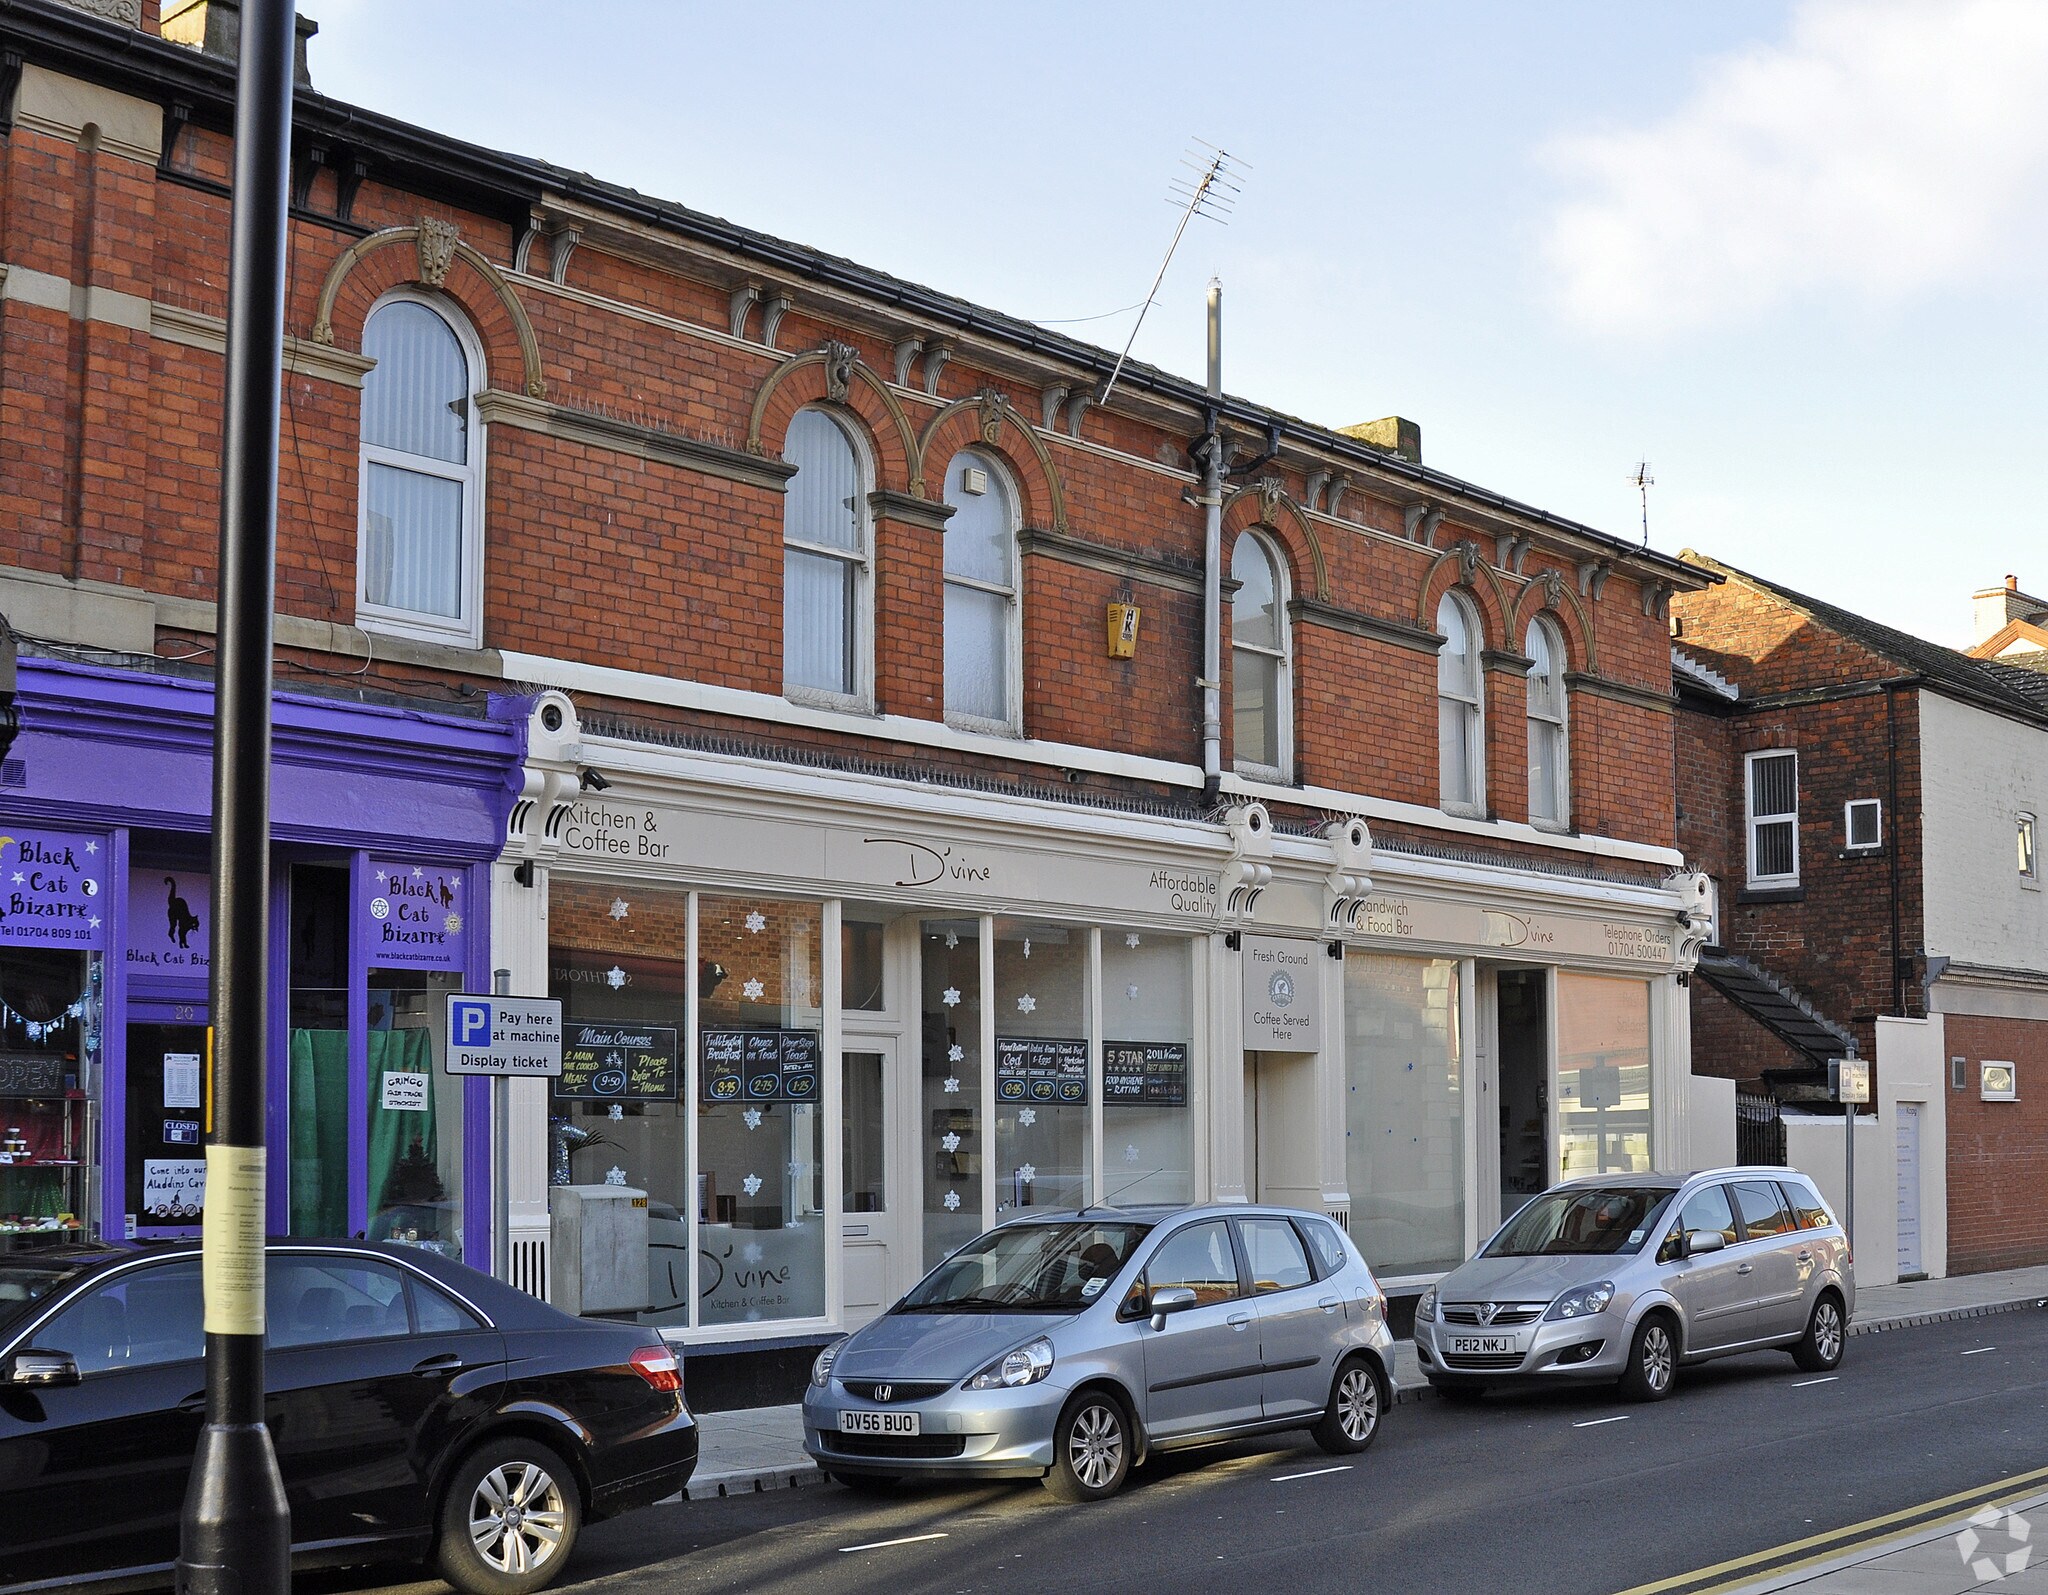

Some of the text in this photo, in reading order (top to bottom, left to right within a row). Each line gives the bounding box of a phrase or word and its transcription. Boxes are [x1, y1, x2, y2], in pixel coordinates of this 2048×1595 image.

[566, 802, 657, 832] Kitchen &
[566, 827, 669, 857] Coffee Bar
[19, 841, 80, 872] Black
[30, 872, 68, 893] Cat
[388, 875, 438, 904] Black
[1149, 871, 1216, 895] Affordable
[9, 893, 88, 919] Bizarre
[399, 903, 429, 922] Cat
[1171, 893, 1217, 919] Quality
[1356, 915, 1413, 935] & Food Bar
[1, 926, 91, 939] Tel 01704 809 101
[381, 922, 446, 945] Bizarre
[1603, 924, 1671, 945] Telephone Orders
[126, 949, 159, 966] Black
[164, 952, 184, 964] Cat
[376, 953, 450, 962] www.blackcatbizarre.co.uk
[1254, 949, 1308, 965] Fresh Ground
[1608, 941, 1666, 960] 01704 500447
[175, 1005, 193, 1020] 20
[500, 1012, 552, 1025] Pay here
[1254, 1012, 1310, 1026] Coffee Served
[462, 1008, 485, 1042] P
[493, 1030, 559, 1042] at machine
[579, 1027, 652, 1046] Main Courses
[1272, 1027, 1292, 1040] Here
[461, 1054, 548, 1068] Display ticket
[573, 1052, 594, 1060] MAIN
[639, 1055, 667, 1067] Please
[1003, 1053, 1022, 1066] Cod
[1107, 1050, 1144, 1065] 5 STAR
[1146, 1049, 1163, 1060] 2011
[576, 1062, 599, 1070] COOKED
[653, 1067, 665, 1078] To
[564, 1073, 587, 1083] MEALS
[1105, 1076, 1144, 1085] FOOD HYGIENE
[640, 1081, 665, 1093] Menu
[1114, 1085, 1140, 1094] RATING
[165, 1122, 198, 1131] CLOSED
[150, 1166, 170, 1175] Come
[174, 1166, 190, 1174] into
[147, 1177, 206, 1189] Aladdins Cav
[633, 1199, 646, 1207] 128
[710, 1299, 739, 1309] Kitchen
[750, 1298, 775, 1308] Coffee
[1455, 1339, 1507, 1352] PE12 NKJ
[846, 1413, 912, 1431] DV56 BUO
